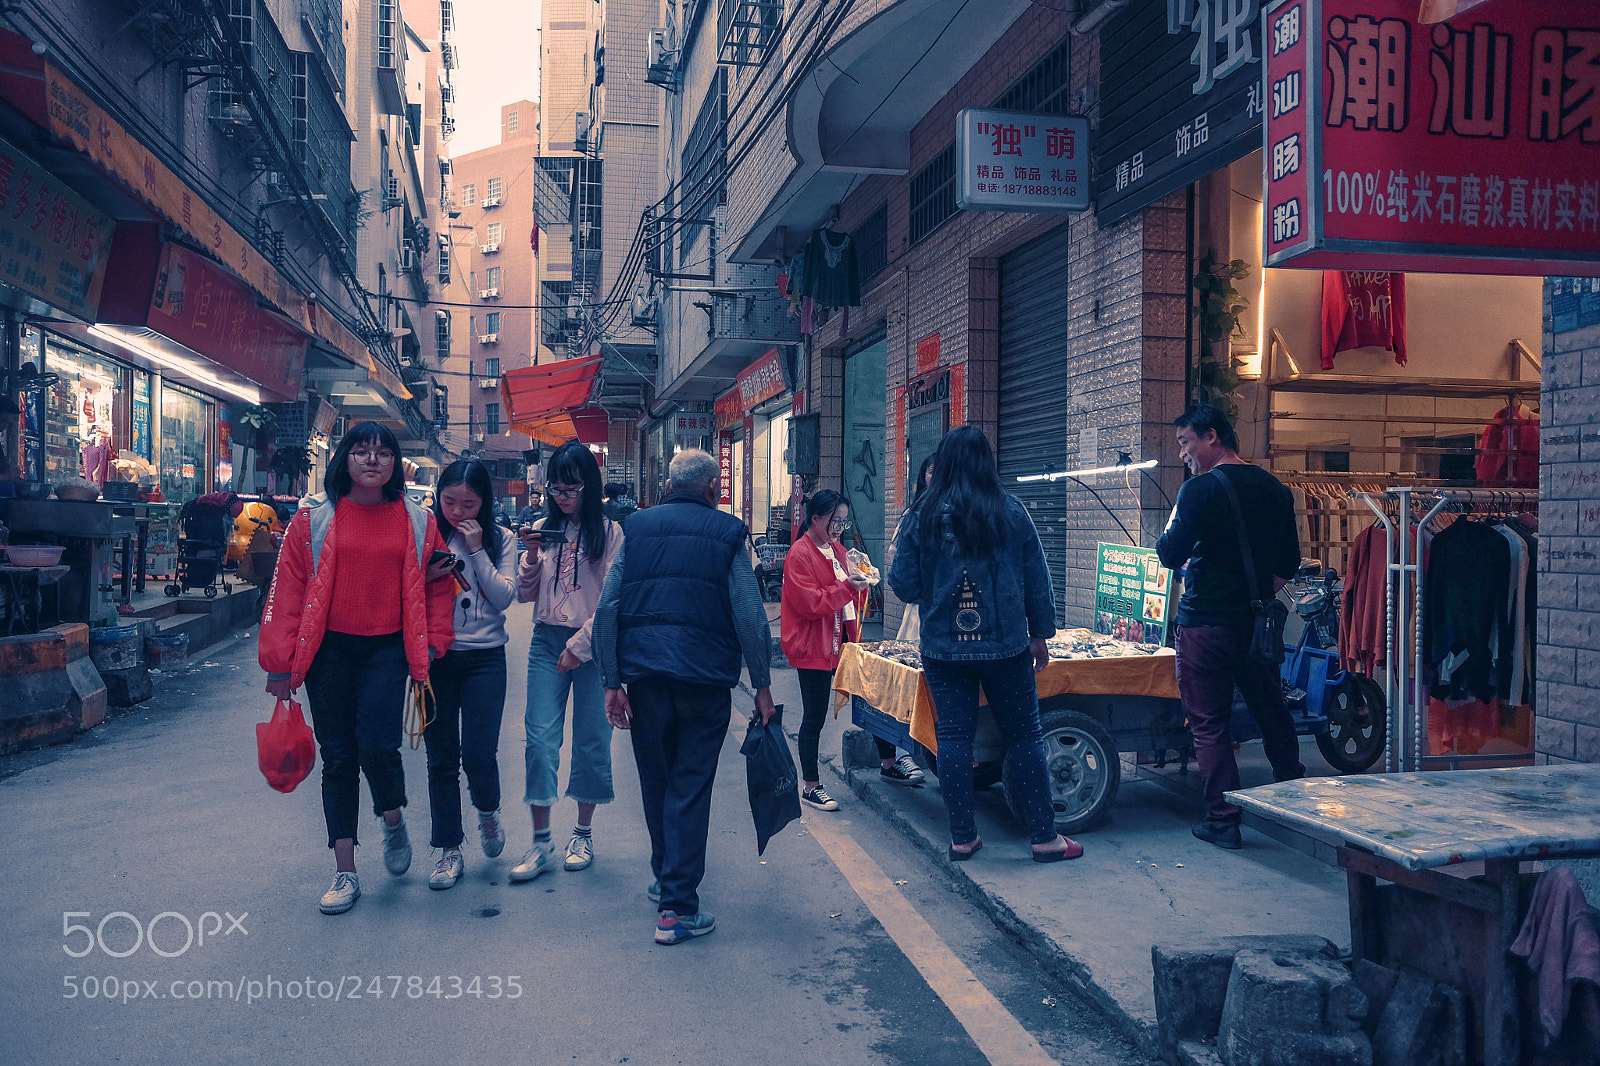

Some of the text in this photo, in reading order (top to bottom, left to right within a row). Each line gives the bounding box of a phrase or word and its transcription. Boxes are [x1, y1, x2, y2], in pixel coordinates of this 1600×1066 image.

[1272, 5, 1301, 244] 潮汕肠粉
[1115, 151, 1144, 192] 精品
[1175, 112, 1209, 158] 饰品
[976, 164, 1078, 182] 精品 饰品 礼品
[677, 417, 708, 430] 麻辣烫
[268, 566, 279, 603] CATCH
